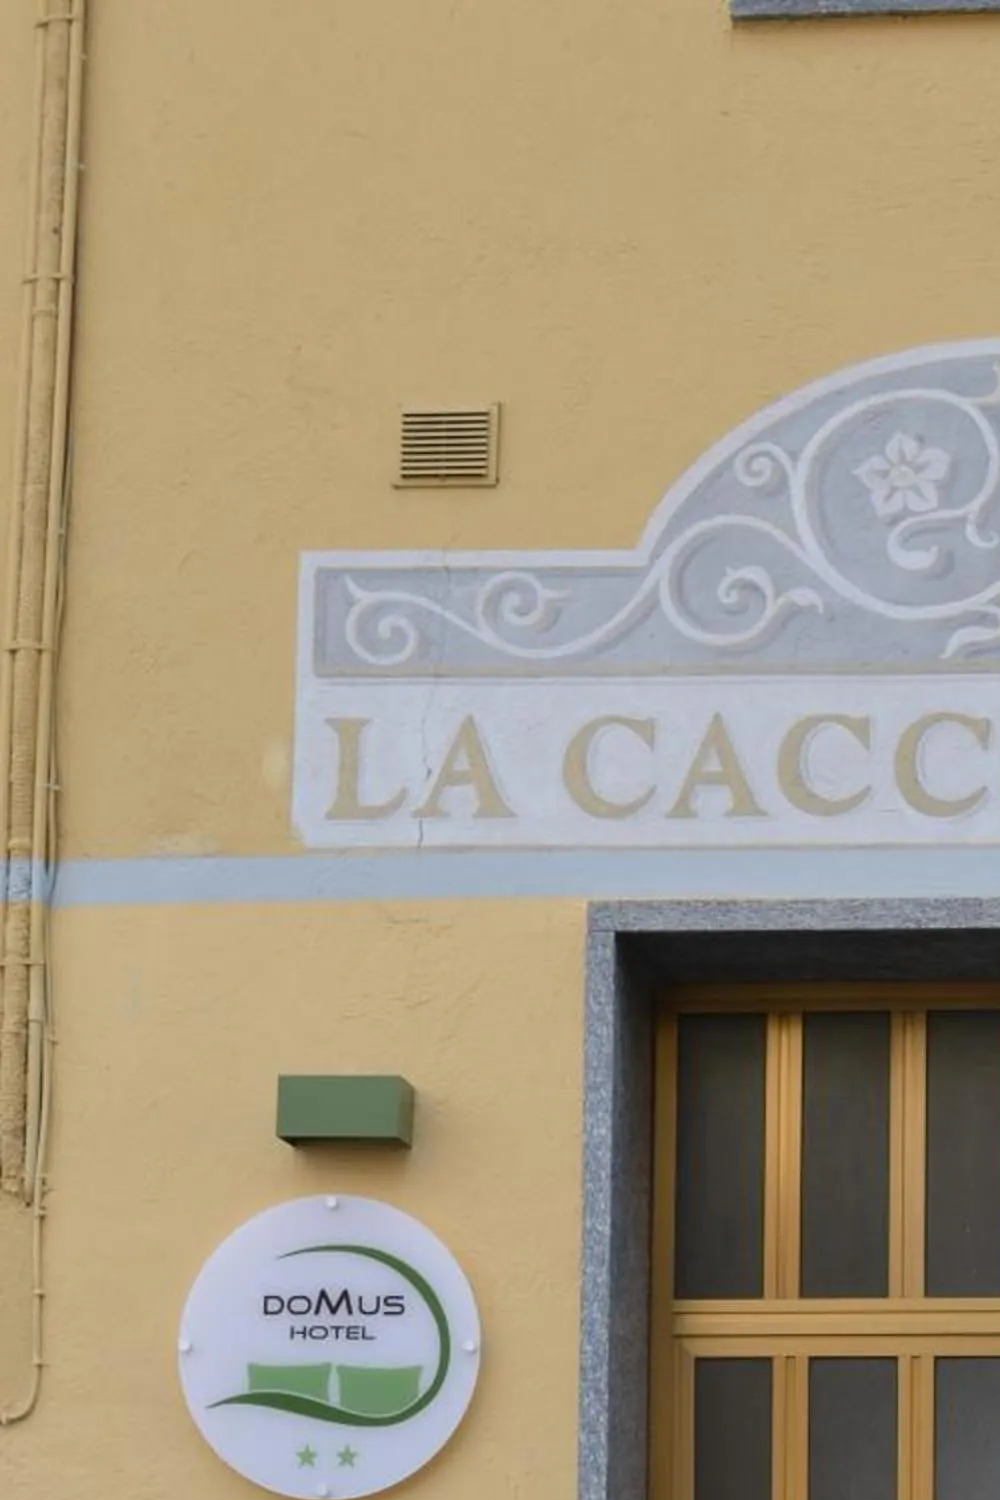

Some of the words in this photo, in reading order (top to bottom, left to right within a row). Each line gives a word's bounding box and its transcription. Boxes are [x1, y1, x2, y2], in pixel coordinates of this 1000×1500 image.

[323, 713, 516, 820] LA
[262, 1288, 405, 1317] DOMUS
[289, 1325, 376, 1341] HOTEL
